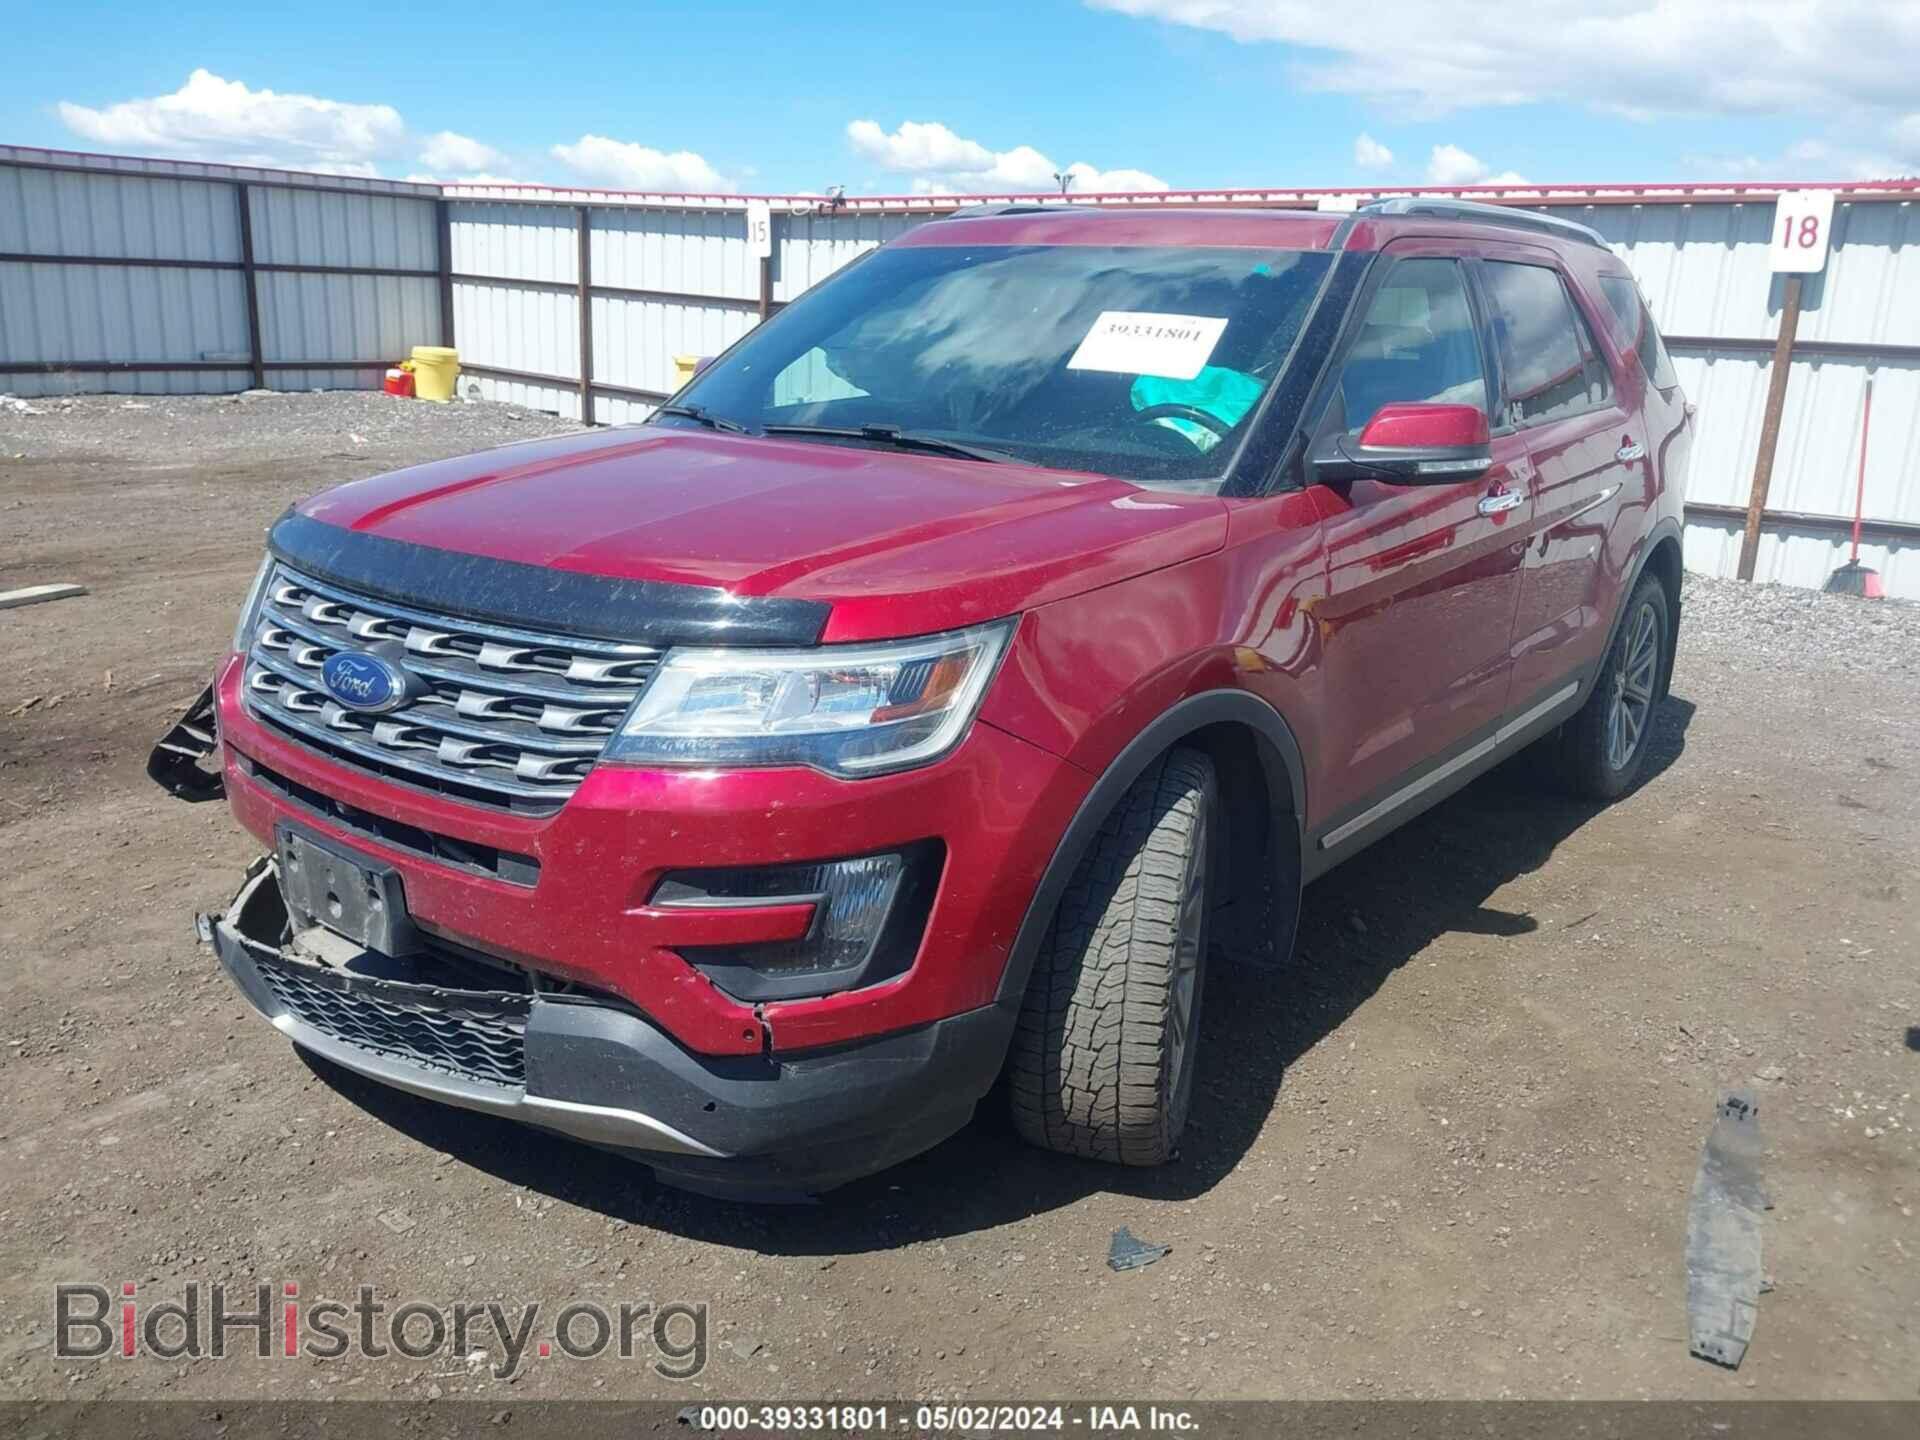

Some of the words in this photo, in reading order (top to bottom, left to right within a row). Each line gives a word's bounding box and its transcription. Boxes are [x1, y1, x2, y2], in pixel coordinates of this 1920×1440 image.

[752, 220, 767, 243] 15
[1783, 215, 1819, 249] 18
[1101, 322, 1202, 343] 39331801
[329, 659, 377, 698] Ford
